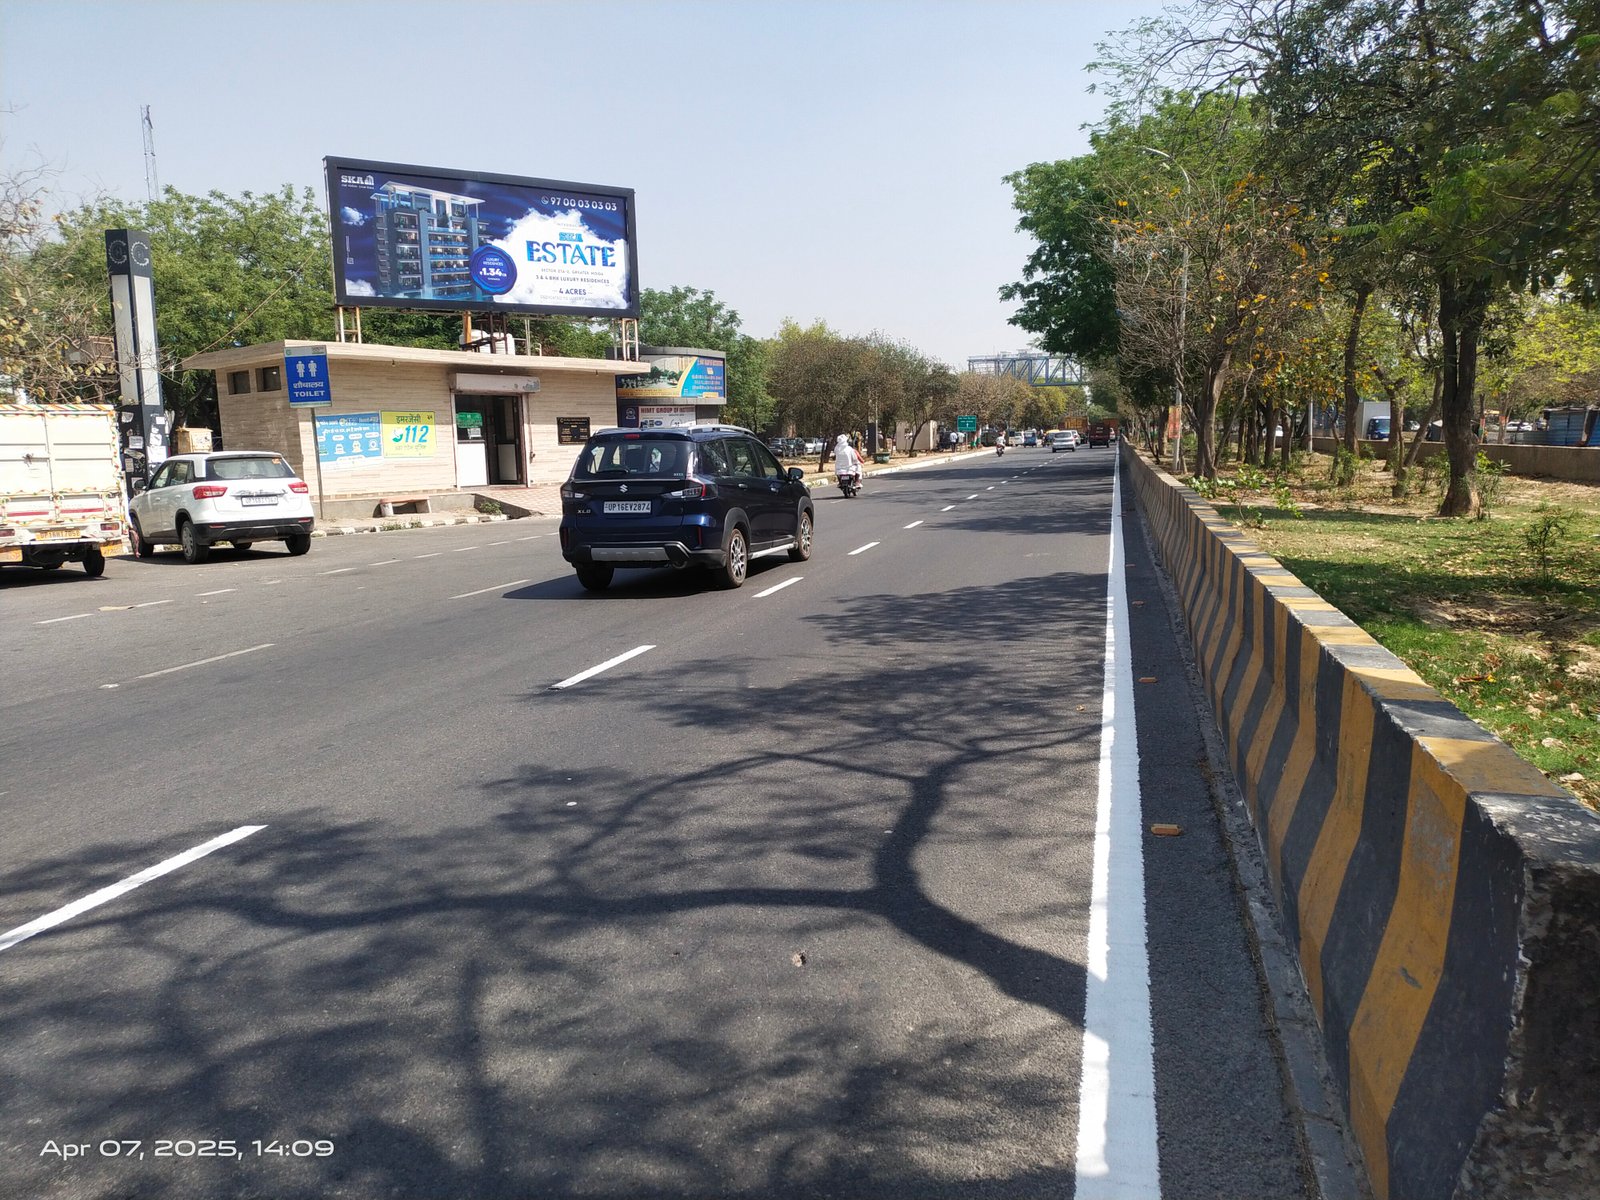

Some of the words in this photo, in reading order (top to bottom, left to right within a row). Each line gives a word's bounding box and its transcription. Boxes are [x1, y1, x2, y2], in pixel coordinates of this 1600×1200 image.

[550, 197, 561, 206] 97
[563, 198, 576, 207] 00
[578, 199, 590, 208] 03
[591, 200, 604, 210] 03
[605, 202, 617, 211] 03
[526, 240, 616, 267] ESTATE
[293, 381, 324, 389] शौचालय
[405, 425, 429, 443] 112
[608, 501, 650, 511] UP16EV2874
